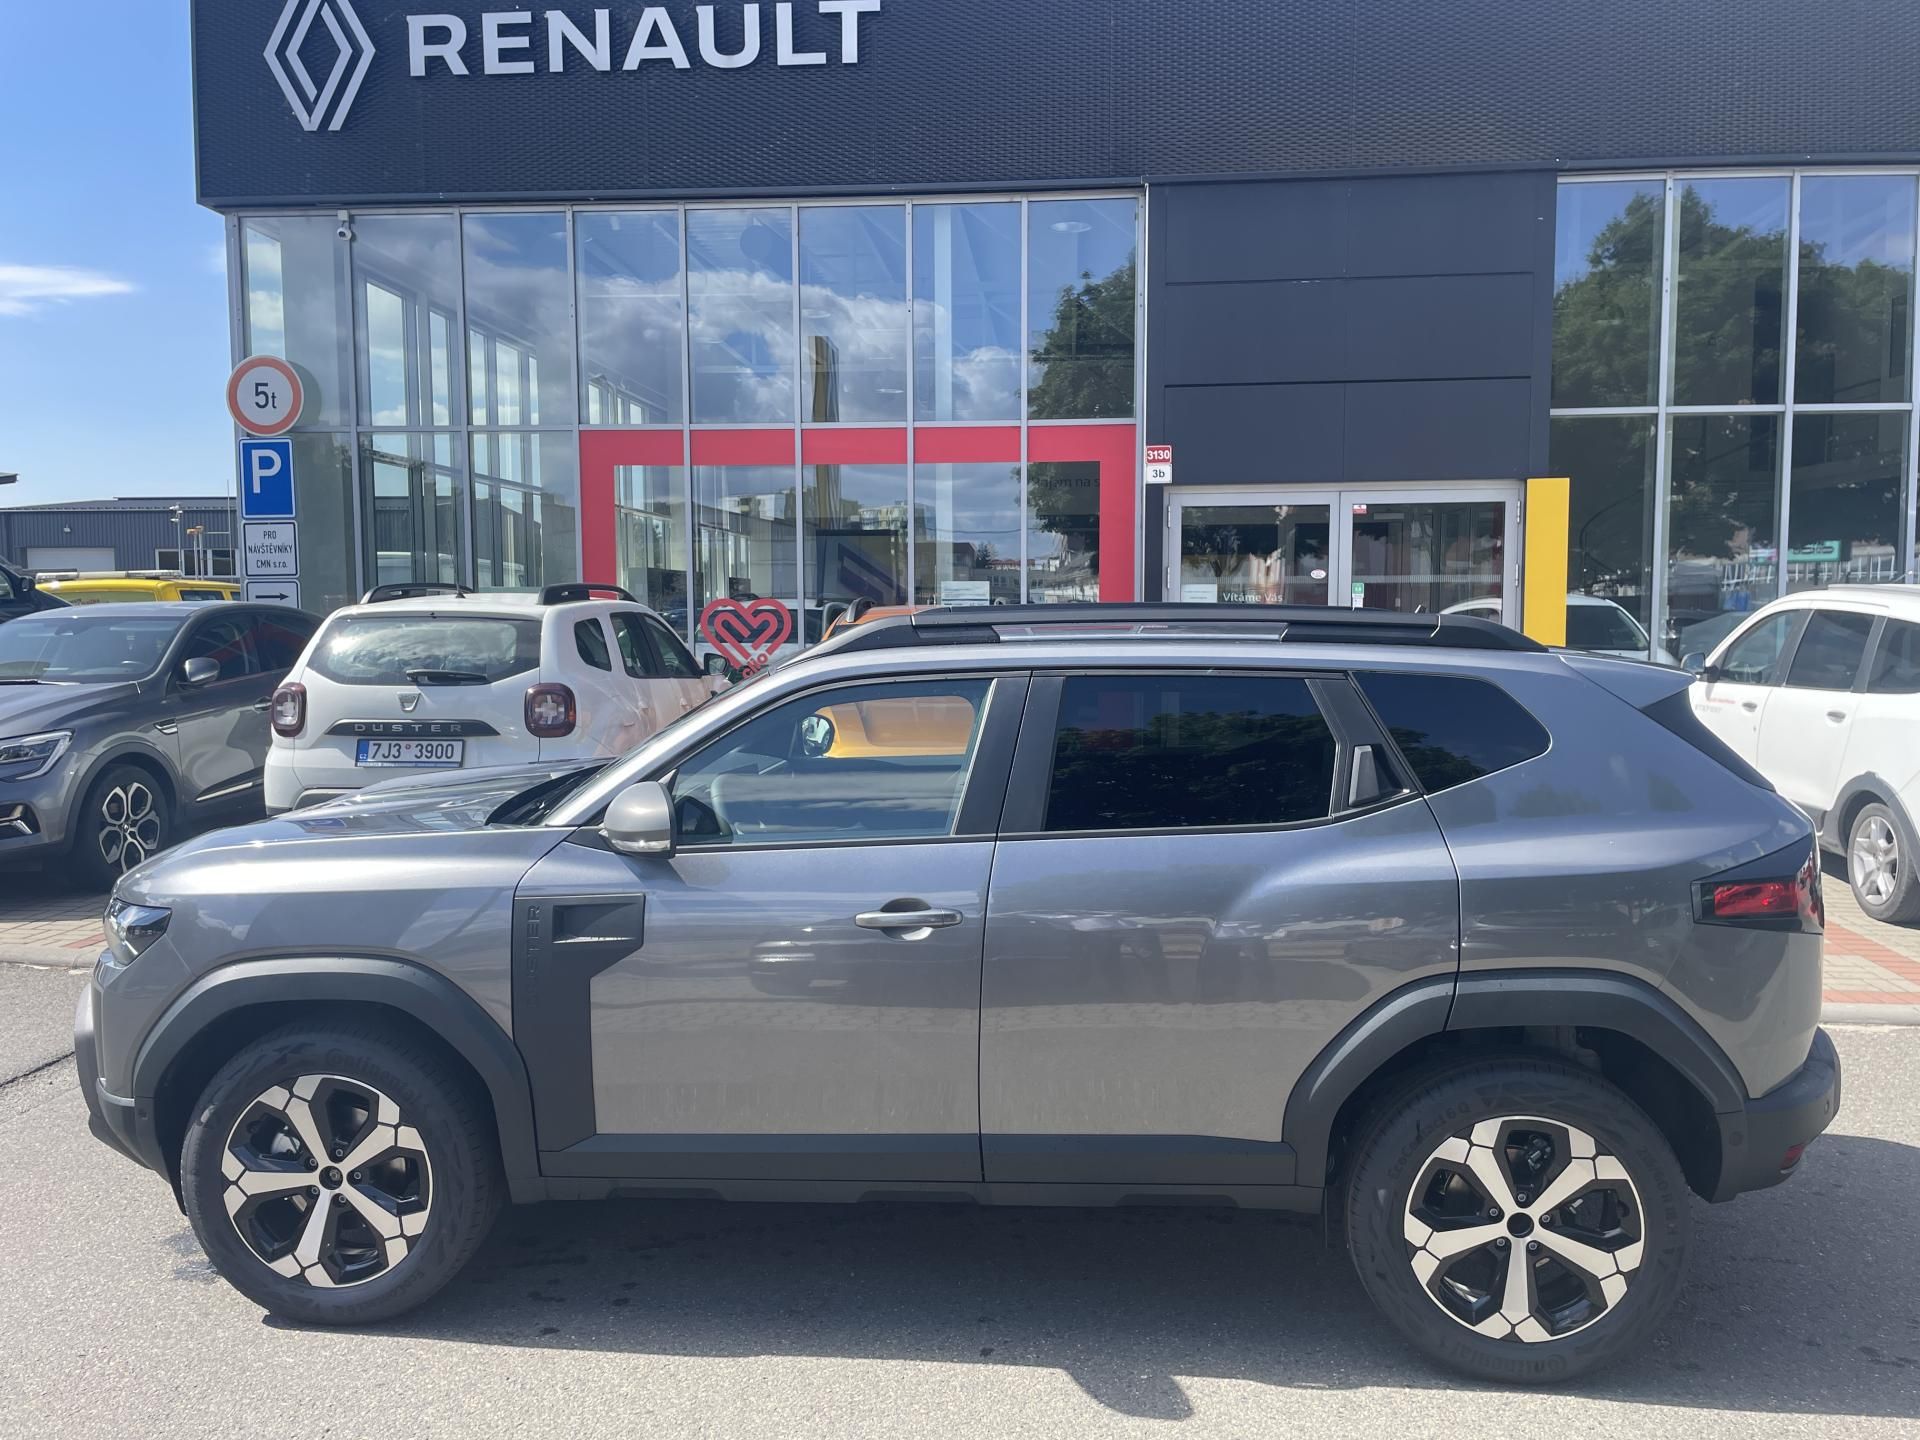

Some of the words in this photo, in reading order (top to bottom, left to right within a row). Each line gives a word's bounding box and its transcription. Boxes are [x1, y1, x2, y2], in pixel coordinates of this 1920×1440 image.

[406, 0, 880, 77] RENAULT
[254, 382, 277, 409] 5t
[1147, 450, 1170, 460] 3130
[251, 449, 282, 494] P
[1152, 469, 1165, 478] 3b
[263, 530, 277, 540] PRO
[248, 542, 293, 554] NÁVŠTĚVNÍKY
[256, 560, 271, 569] CMN
[272, 561, 288, 569] s.r.o.
[1222, 592, 1261, 602] Vítáme
[1264, 592, 1283, 602] Vás
[354, 724, 462, 732] DUSTER
[372, 743, 402, 759] 7J3
[414, 743, 455, 759] 3900
